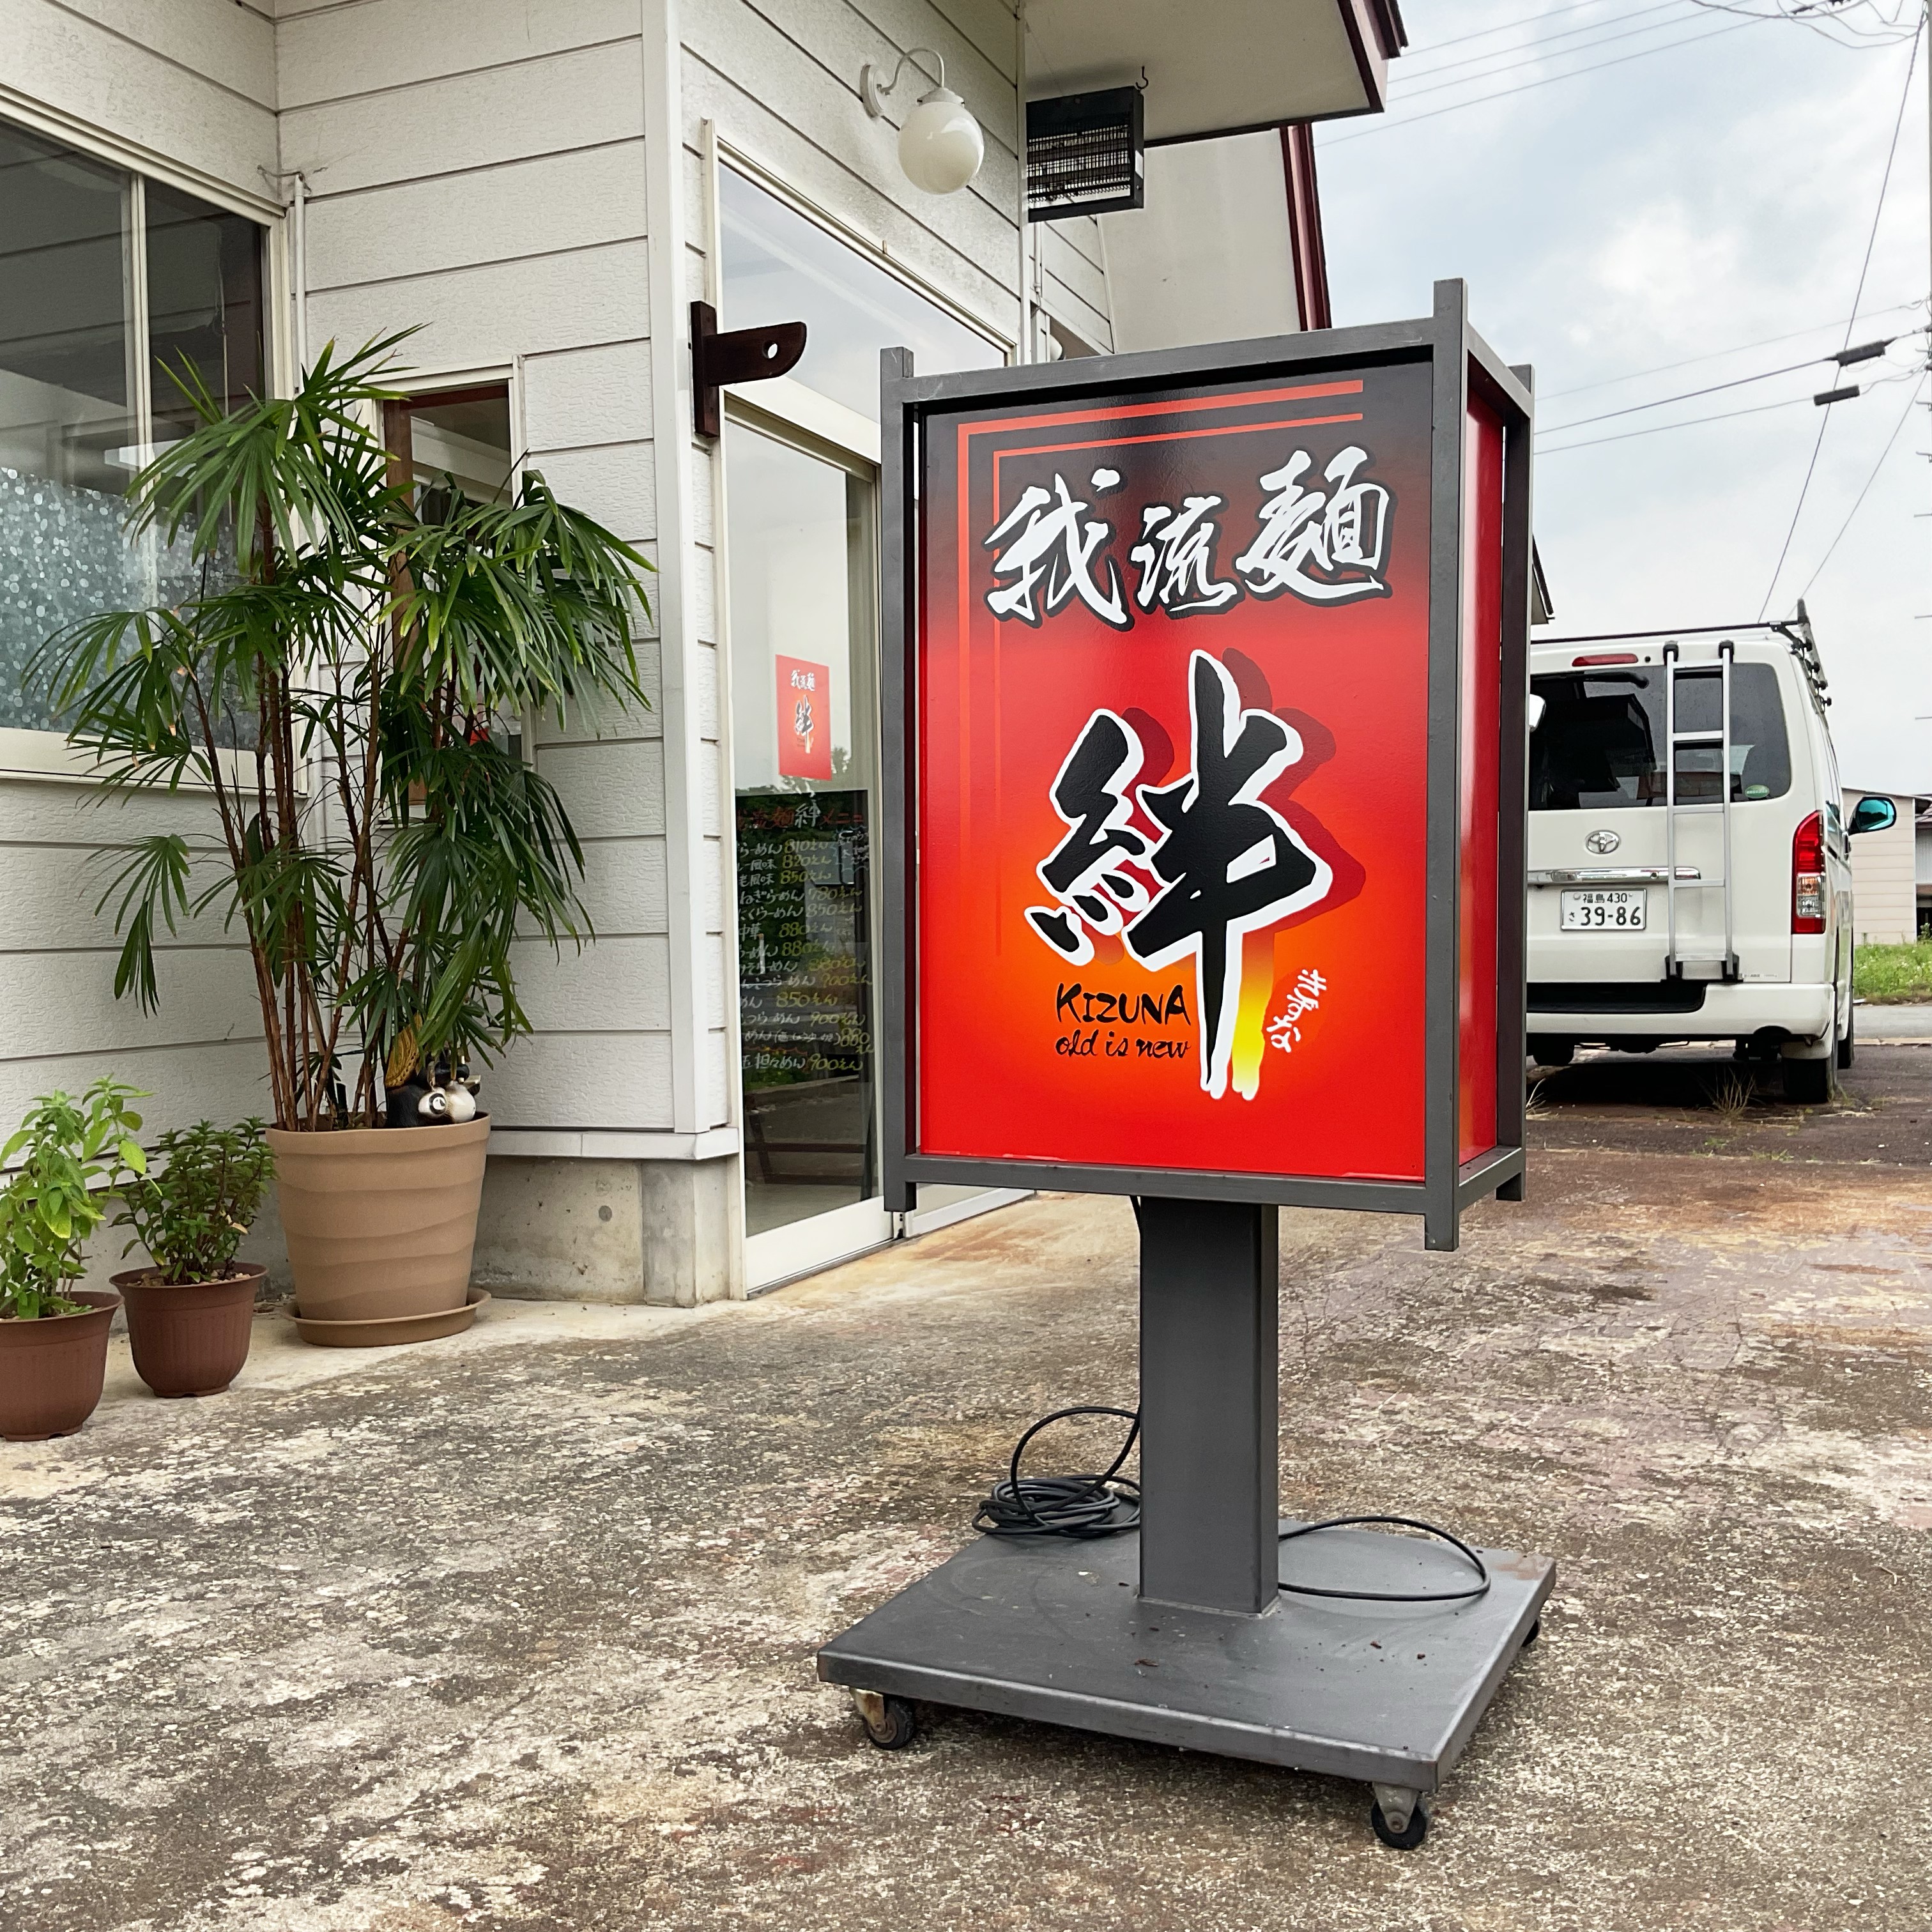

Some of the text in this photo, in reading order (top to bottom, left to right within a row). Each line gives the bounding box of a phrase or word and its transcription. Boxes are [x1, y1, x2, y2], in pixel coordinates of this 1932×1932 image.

[1025, 649, 1333, 1100] 絆
[1580, 906, 1641, 926] 39-86
[1056, 983, 1192, 1026] KIZUNA
[1055, 1029, 1192, 1059] old is new
